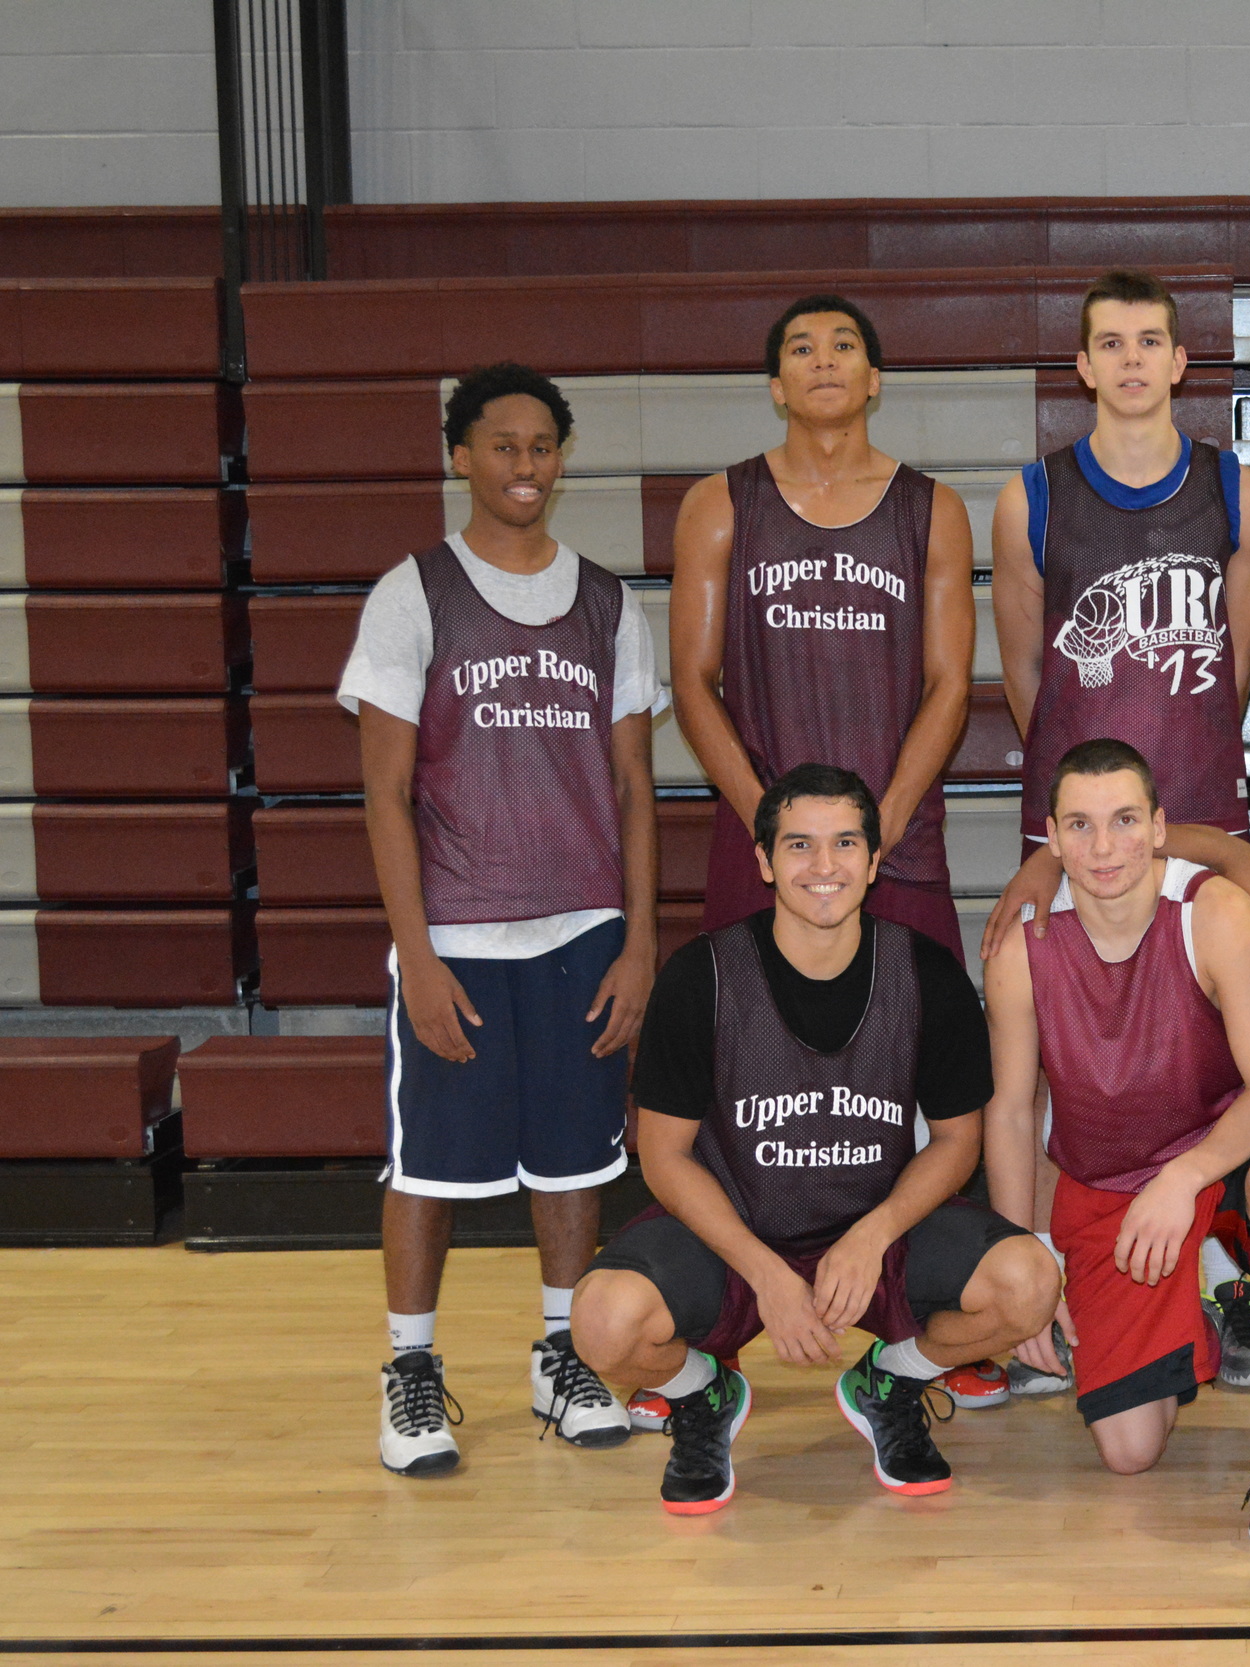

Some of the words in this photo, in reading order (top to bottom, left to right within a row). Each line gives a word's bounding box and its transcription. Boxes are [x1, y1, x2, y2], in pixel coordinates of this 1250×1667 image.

[747, 559, 828, 596] Upper
[833, 552, 906, 603] Room
[766, 604, 886, 631] Christian
[1138, 629, 1219, 649] BASKETBAL
[452, 655, 532, 696] Upper
[474, 702, 591, 730] Christian
[735, 1091, 824, 1131] Upper
[830, 1086, 903, 1126] Room
[755, 1141, 882, 1167] Christian
